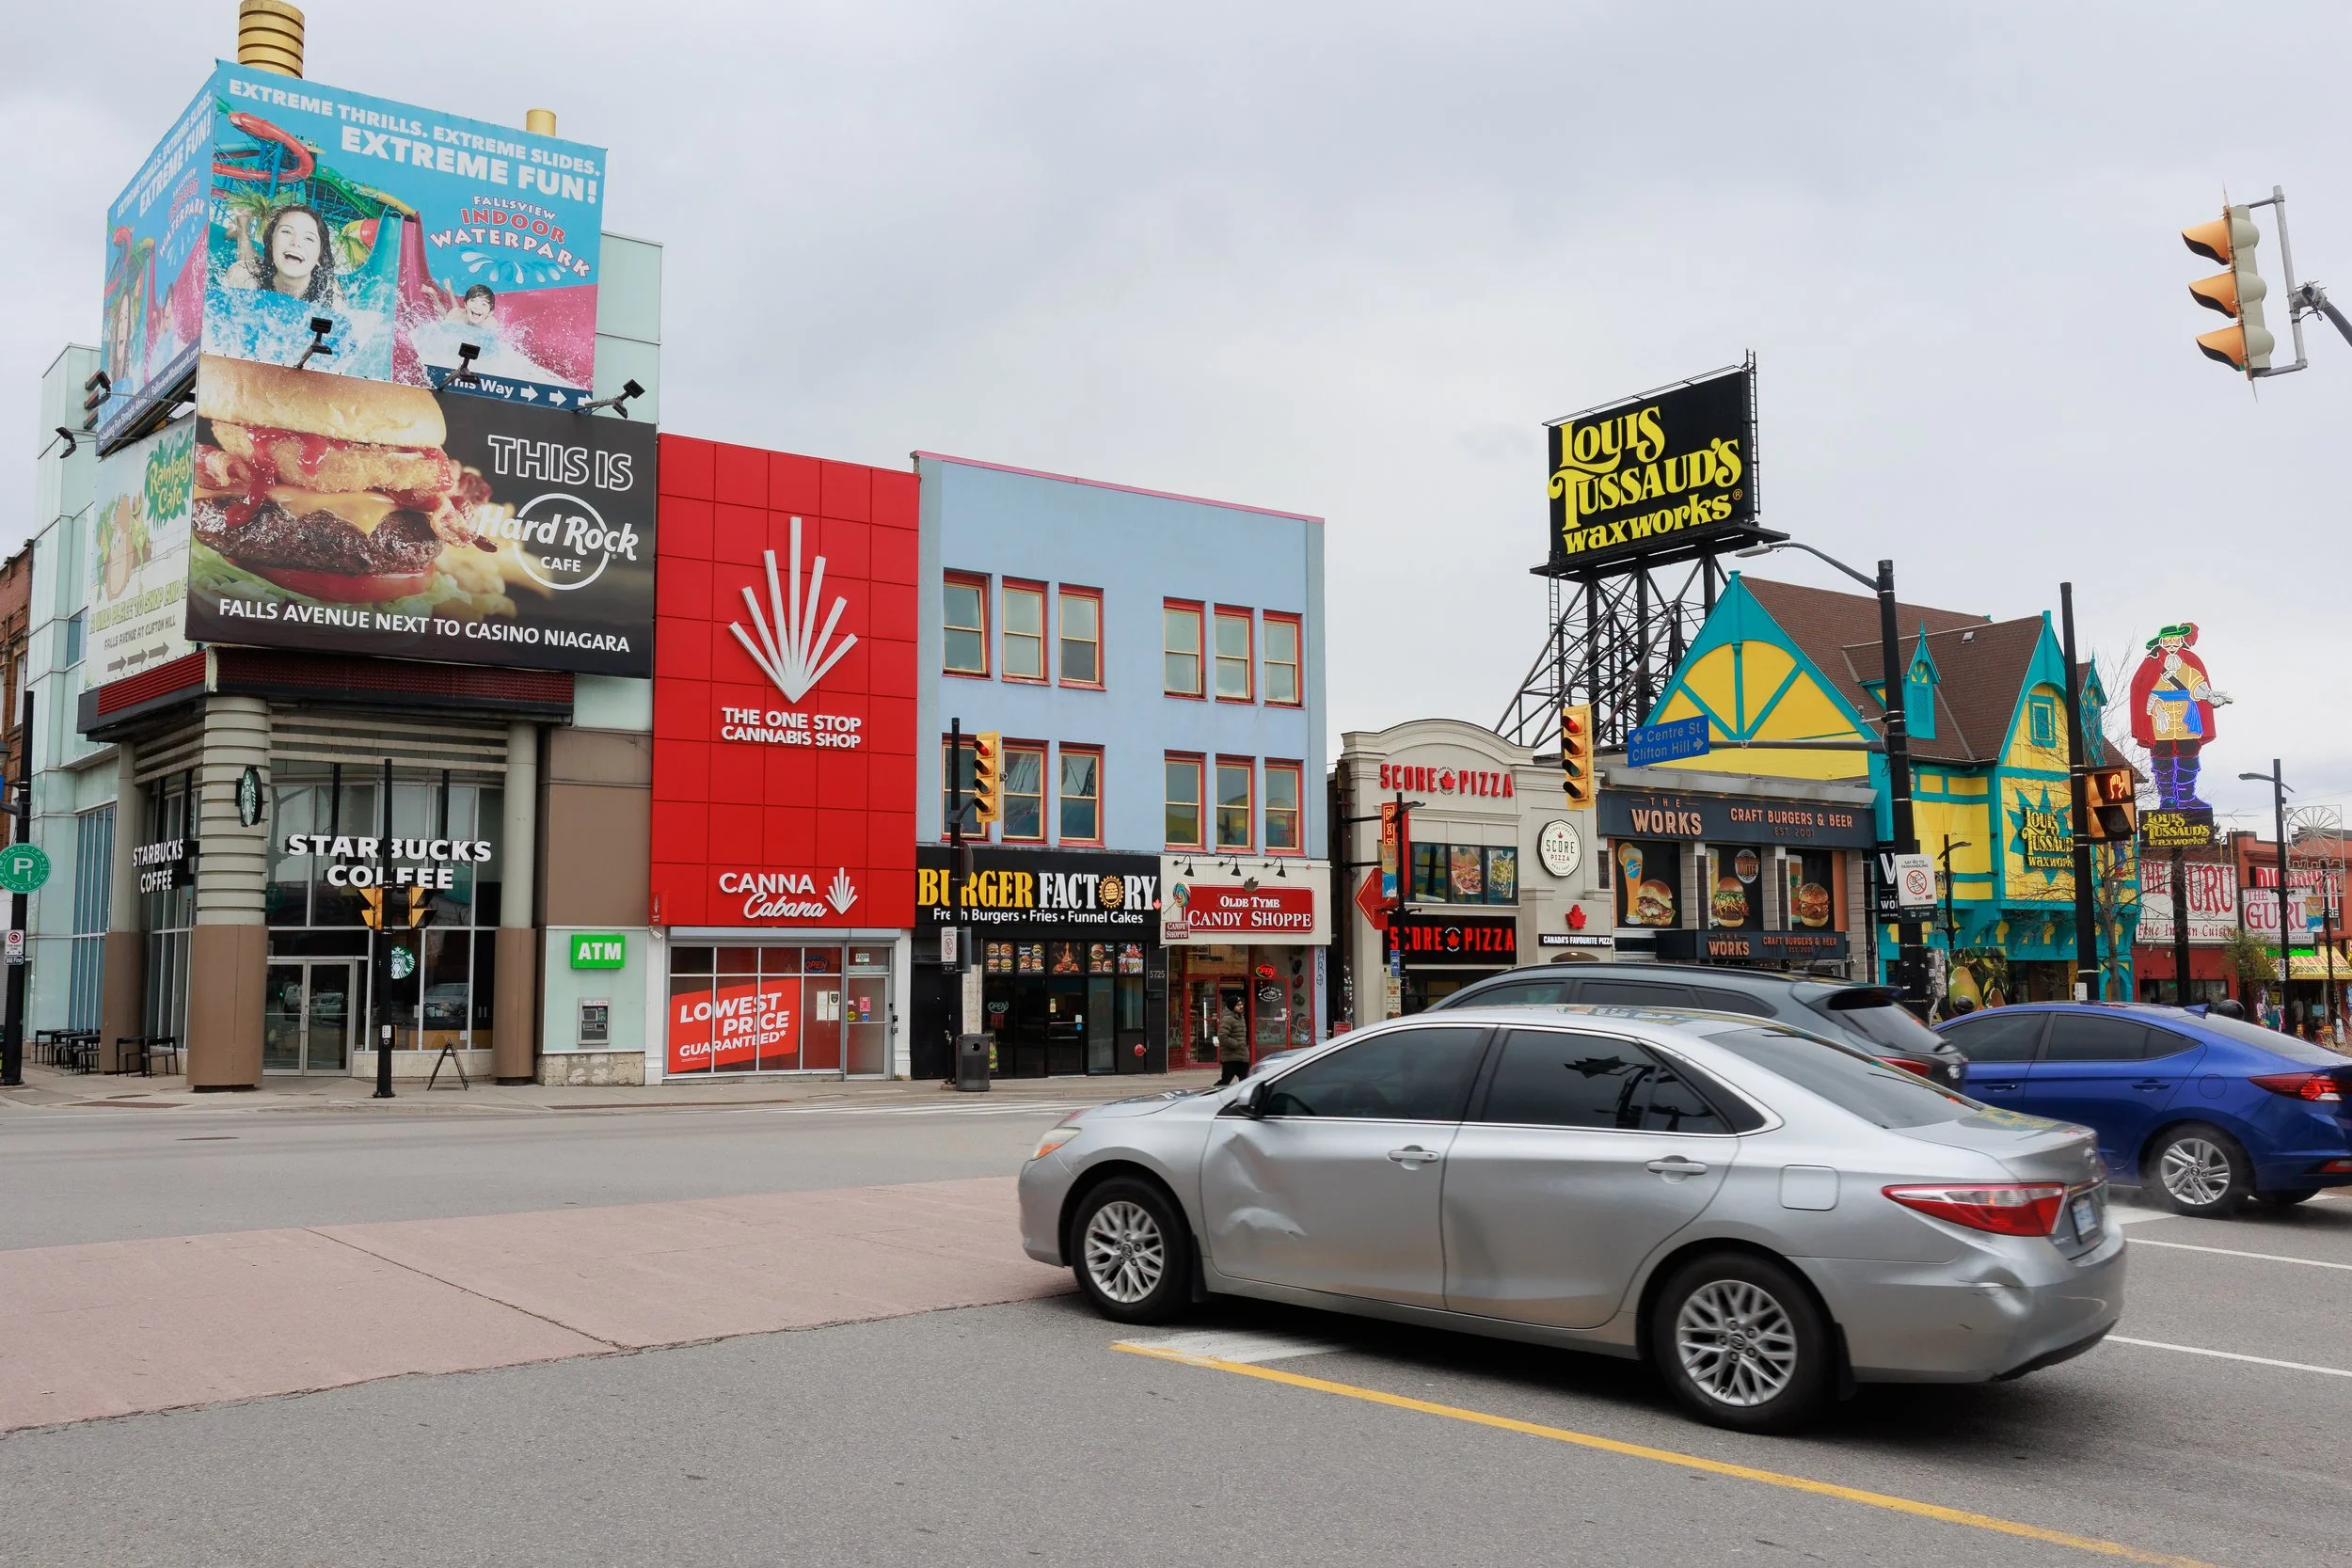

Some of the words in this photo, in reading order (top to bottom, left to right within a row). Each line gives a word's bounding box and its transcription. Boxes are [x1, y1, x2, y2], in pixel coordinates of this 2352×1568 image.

[230, 79, 333, 117] EXTREME
[338, 103, 428, 139] THRILLS.
[434, 124, 526, 160] EXTREME
[531, 148, 600, 176] SLIDES.
[140, 143, 183, 217] EXTREME
[185, 111, 212, 163] FUN!
[342, 125, 508, 185] EXTREME
[518, 164, 597, 204] FUN!
[473, 196, 557, 221] FALLSVIEW
[460, 208, 566, 244] INDOOR
[429, 228, 591, 277] WATERPARK
[480, 378, 514, 399] Way
[1559, 405, 1666, 473] LOUIS
[487, 435, 590, 485] THIS
[596, 450, 633, 491] IS
[158, 477, 183, 515] Cafe
[1548, 437, 1742, 531] TUSSAUD'S
[477, 503, 562, 544] Hard
[564, 516, 640, 562] Rock
[1563, 493, 1732, 555] waxworks
[540, 556, 581, 573] CAFE
[144, 586, 164, 614] SHOP
[164, 579, 182, 607] AND
[218, 597, 278, 621] FALLS
[283, 603, 370, 628] AVENUE
[375, 612, 429, 635] NEXT
[434, 618, 461, 637] TO
[465, 622, 539, 644] CASINO
[544, 629, 630, 653] NIAGARA
[722, 706, 760, 727] THE
[765, 710, 808, 730] ONE
[813, 714, 862, 734] STOP
[1647, 727, 1684, 742] Centre
[1688, 722, 1704, 735] St.
[722, 726, 811, 746] CANNABIS
[816, 730, 862, 749] SHOP
[1632, 747, 1667, 762] Clifton
[1672, 739, 1690, 754] Hill
[1380, 764, 1438, 793] SCORE
[1459, 770, 1513, 798] PIZZA
[1649, 797, 1681, 808] THE
[1631, 808, 1702, 836] WORKS
[1730, 807, 1763, 822] CRAFT
[1768, 810, 1813, 825] BURGERS
[1817, 813, 1825, 827] &
[1829, 815, 1852, 828] BEER
[2025, 807, 2060, 836] LOUIS
[2147, 812, 2185, 828] LOUIS
[1794, 828, 1815, 837] 2001
[2022, 824, 2074, 855] TUSSAUD
[133, 838, 183, 867] STARBUCKS
[288, 833, 492, 863] STARBUCKS
[1546, 839, 1575, 854] SCORE
[13, 857, 34, 875] P
[2026, 855, 2074, 868] waxwork
[140, 869, 172, 894] COFFEE
[719, 873, 816, 895] CANNA
[917, 868, 1033, 908] BURGER
[2139, 862, 2166, 895] THE
[2170, 863, 2233, 916] URU
[742, 893, 828, 920] Cabana
[1219, 895, 1249, 908] OLDE
[1250, 896, 1280, 909] TYME
[2247, 890, 2269, 901] THE
[933, 908, 968, 922] Freh
[972, 910, 1020, 924] Burgers
[1030, 910, 1057, 923] Fries
[1068, 911, 1107, 924] Funnel
[1110, 911, 1143, 924] Cakes
[1167, 922, 1187, 930] CANDY
[1188, 910, 1243, 927] CANDY
[1250, 911, 1311, 927] SHOPPE
[2245, 900, 2307, 931] GURU
[1166, 930, 1187, 939] SHOPPE
[1464, 927, 1515, 951] PIZZA
[1543, 936, 1568, 944] CANADA'S
[1569, 936, 1597, 945] FAVOURITE
[1762, 936, 1783, 945] CRAFT
[1785, 937, 1812, 945] BURGERS
[2165, 925, 2198, 937] Inan
[2202, 924, 2233, 937] Cuisin
[578, 942, 622, 959] ATM
[1708, 941, 1750, 956] WORKS
[805, 960, 827, 969] OPEN
[1150, 970, 1166, 978] 5725
[1257, 967, 1276, 976] OPEN
[680, 992, 782, 1023] LOWEST
[989, 1002, 1008, 1010] OPEN
[723, 1010, 790, 1036] PRICE
